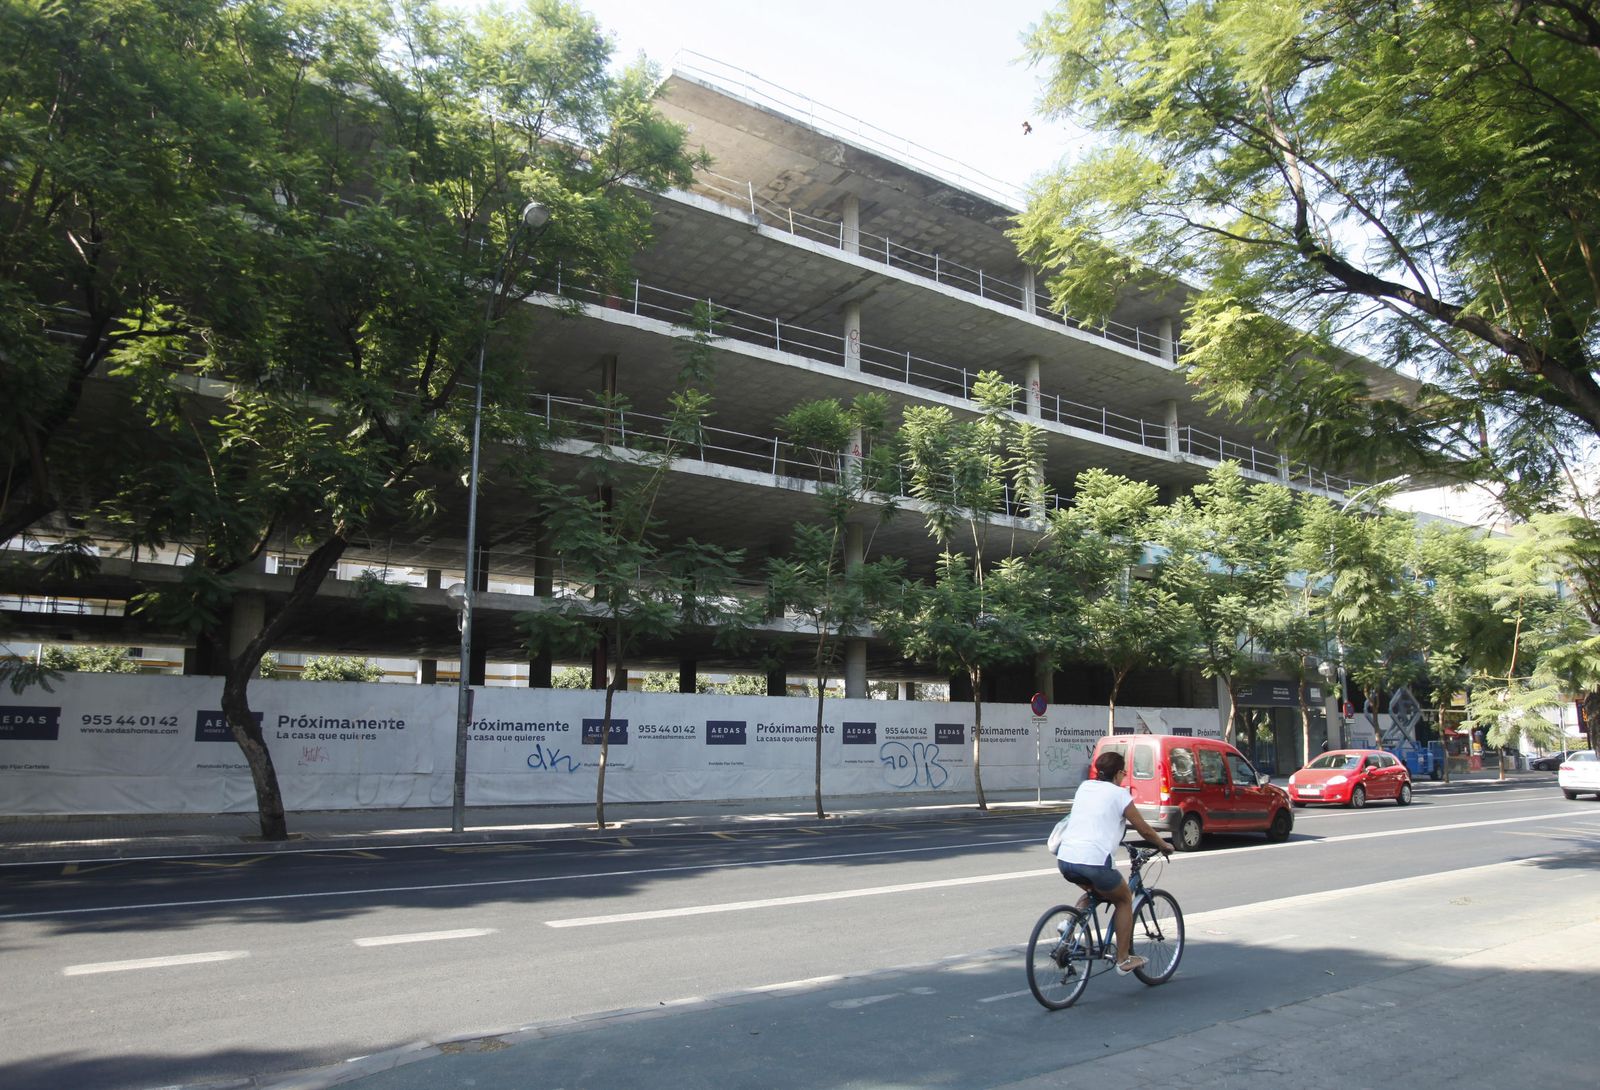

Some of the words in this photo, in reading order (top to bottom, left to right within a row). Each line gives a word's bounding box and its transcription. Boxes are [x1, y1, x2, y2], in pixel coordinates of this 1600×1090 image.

[2, 715, 47, 724] EDAS
[81, 714, 112, 726] 955
[115, 715, 136, 726] 44
[140, 715, 156, 726] 01
[159, 716, 178, 727] 42
[278, 714, 405, 730] Próximamente
[466, 718, 569, 732] róximamente
[638, 724, 657, 733] 955
[658, 725, 670, 733] 44
[672, 725, 682, 733] 01
[683, 725, 696, 734] 42
[80, 727, 179, 735] www.aedashomes.com
[885, 727, 899, 735] 955
[909, 727, 918, 735] 01
[918, 727, 928, 735] 42
[970, 725, 1029, 736] Póximamente
[1055, 726, 1106, 736] Próximamente
[276, 731, 289, 740] La
[291, 732, 316, 740] casa
[318, 733, 337, 741] que
[496, 734, 513, 742] que
[514, 733, 546, 742] quieres
